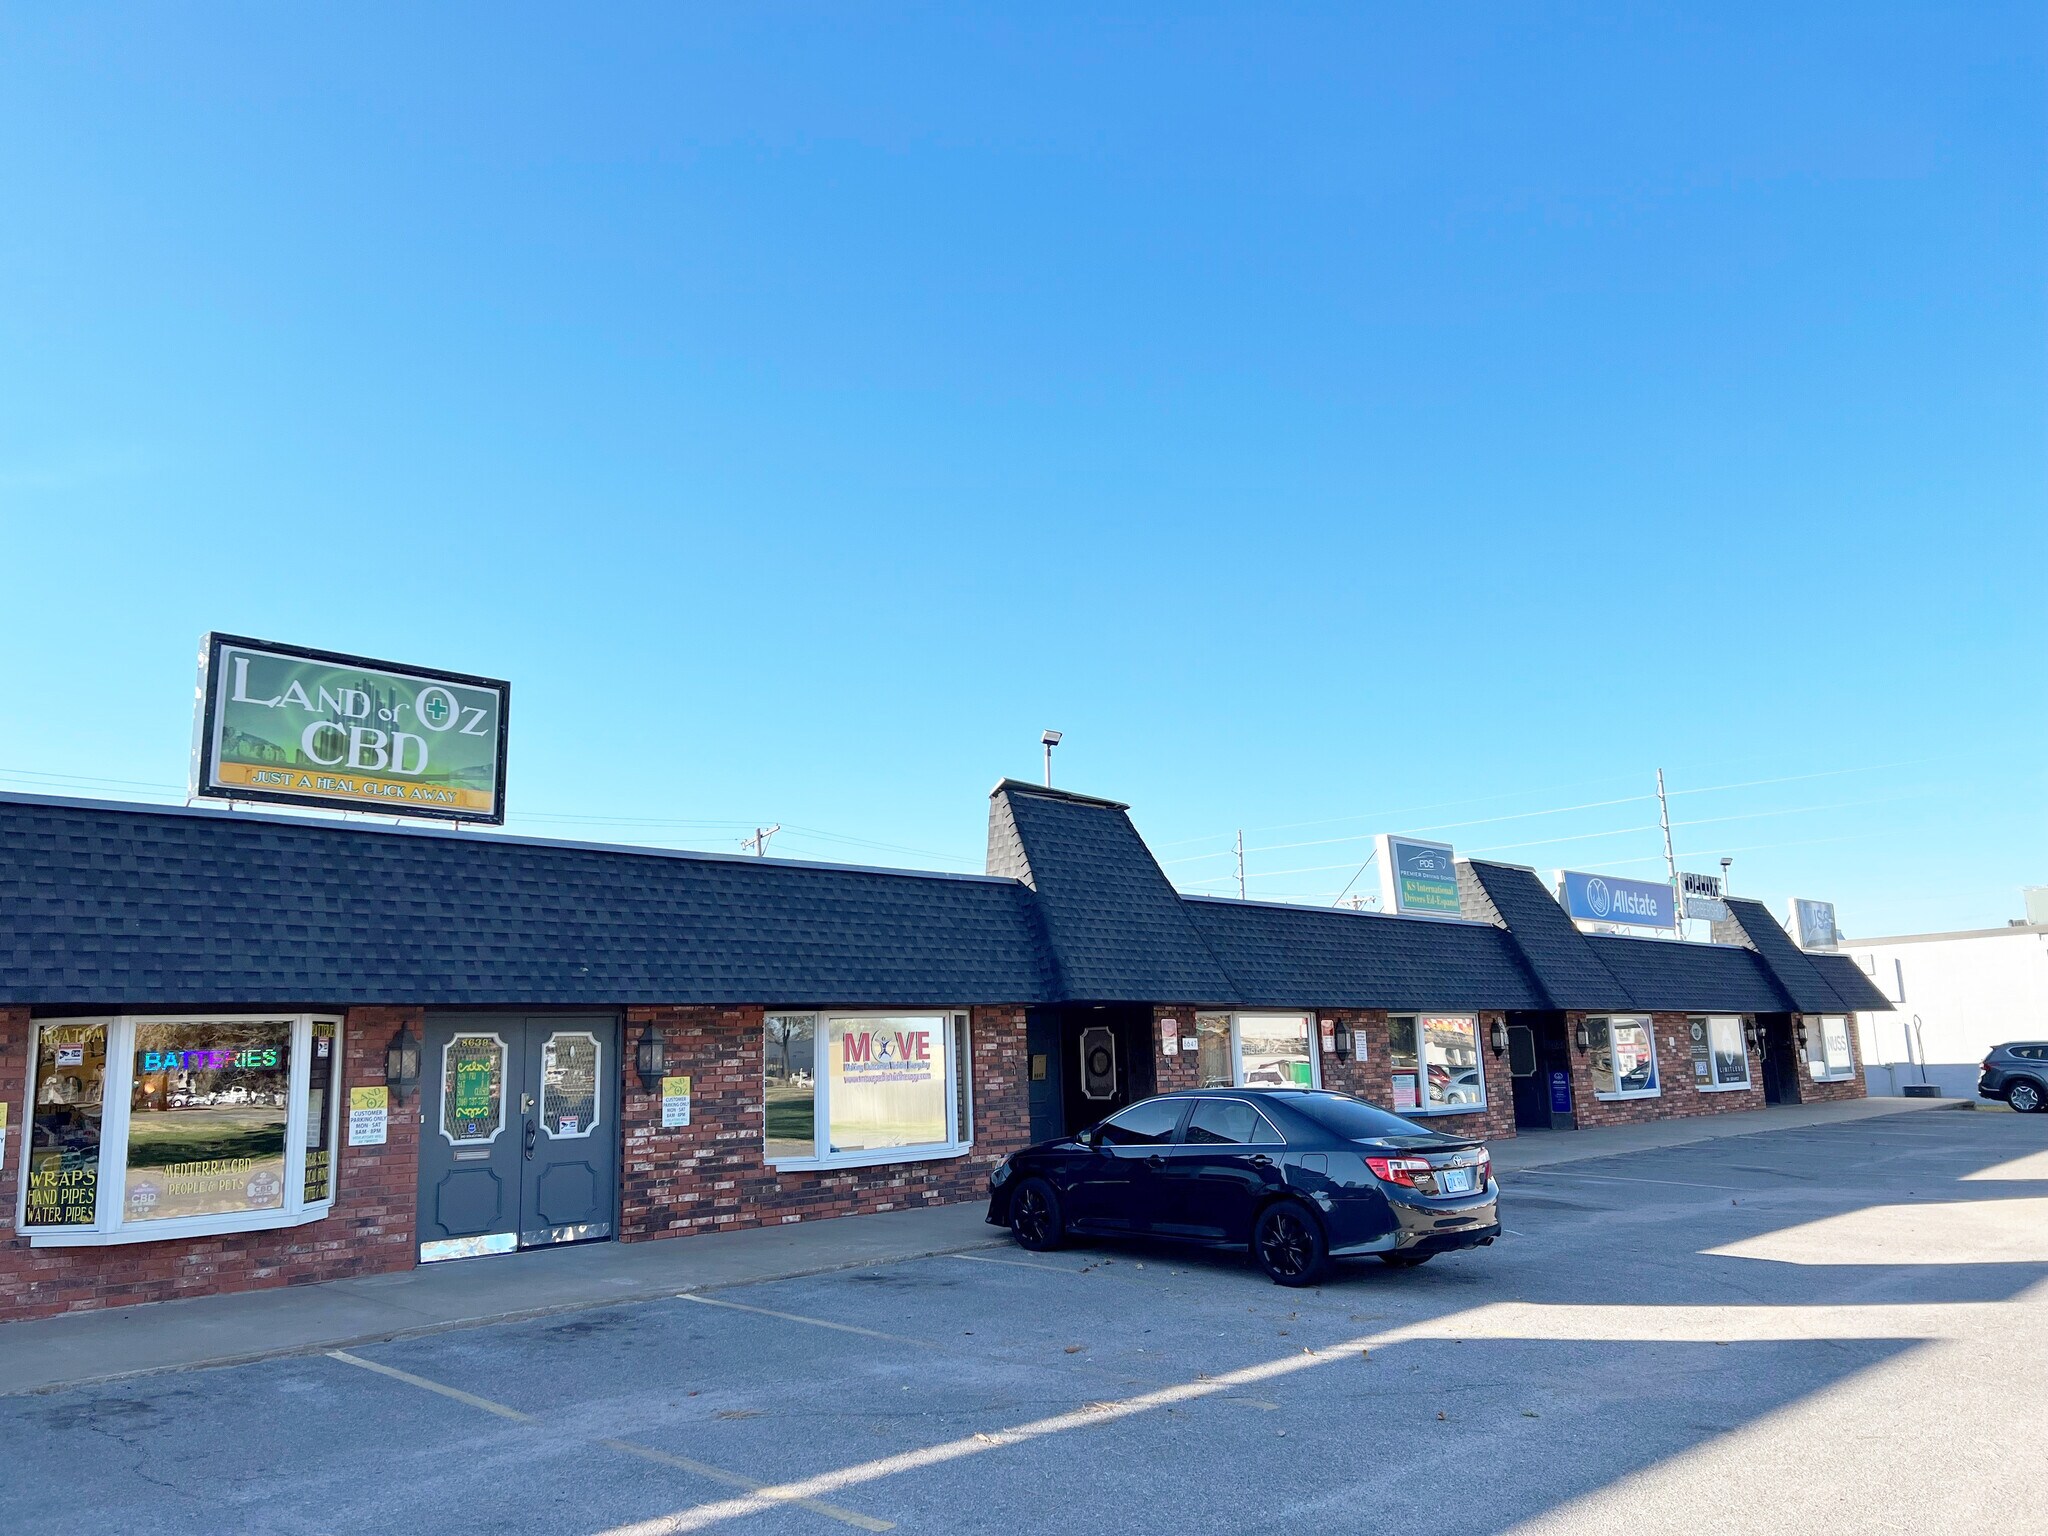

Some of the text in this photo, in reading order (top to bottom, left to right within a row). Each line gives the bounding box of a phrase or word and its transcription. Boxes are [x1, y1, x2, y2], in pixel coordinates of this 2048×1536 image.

[232, 657, 371, 719] LAND
[301, 720, 429, 776] CBD
[252, 770, 458, 804] JUST A HEAL CLICK AWAY
[1419, 859, 1434, 869] PDS
[1400, 870, 1422, 878] PREMIER
[1416, 881, 1454, 896] International
[1685, 873, 1722, 898] DELUXE
[1612, 889, 1658, 917] Allstate
[40, 1027, 105, 1045] KRATOM
[461, 1038, 489, 1047] 8639
[1826, 1035, 1847, 1052] NUSS
[842, 1030, 931, 1063] MOVE
[144, 1048, 277, 1071] BATTERIES
[351, 1087, 381, 1105] LAND
[353, 1109, 383, 1117] CUSTOMER
[29, 1168, 96, 1187] WRAPS
[162, 1158, 252, 1179] MEDTERRA CBD
[168, 1180, 207, 1196] PEOPLE
[218, 1178, 245, 1192] PETS
[253, 1185, 273, 1194] CBD
[27, 1187, 95, 1206] HAND PIPES
[131, 1193, 156, 1204] CBD
[27, 1205, 94, 1223] WATER PIPES
